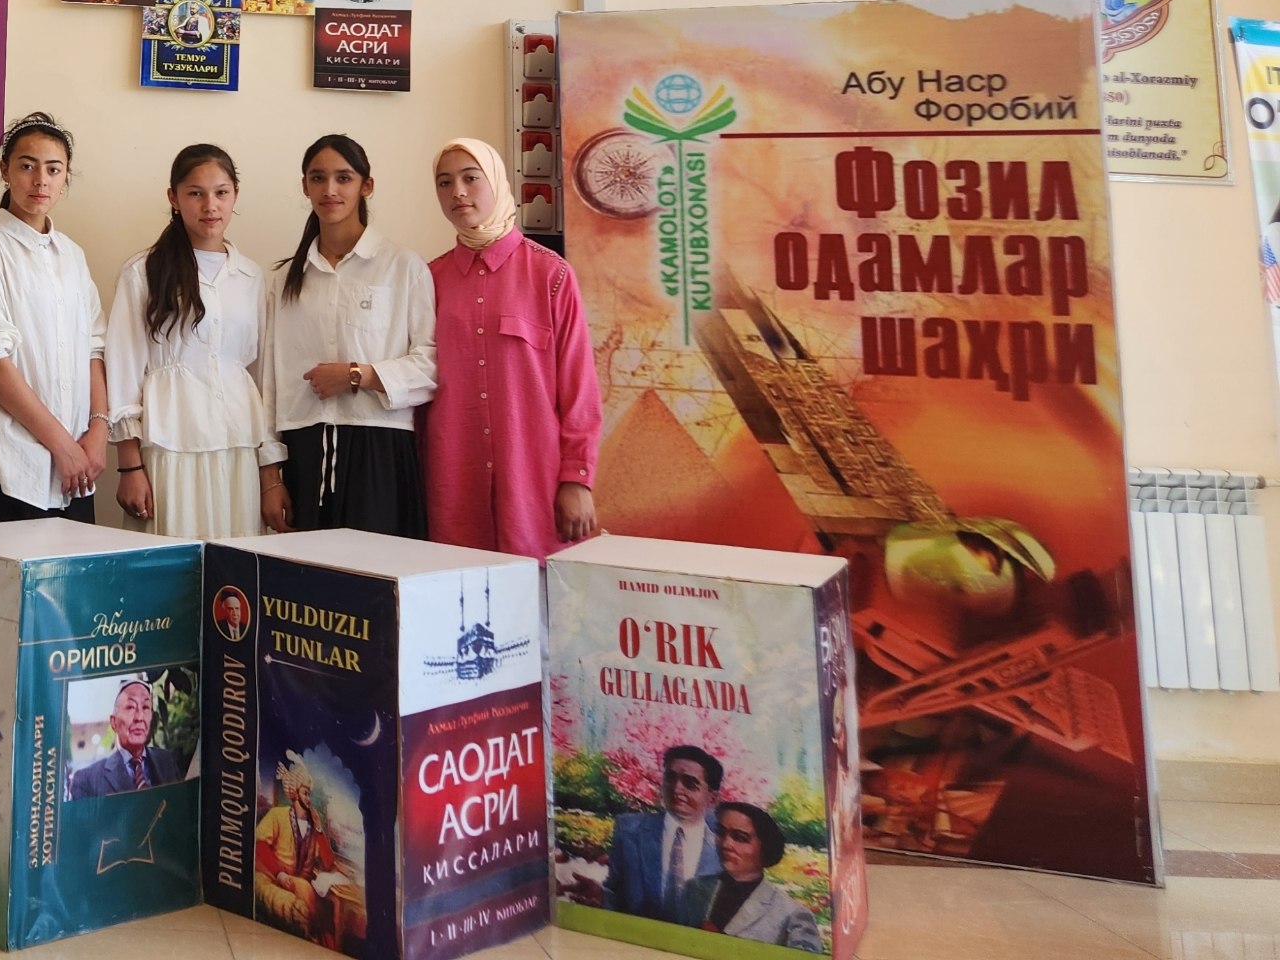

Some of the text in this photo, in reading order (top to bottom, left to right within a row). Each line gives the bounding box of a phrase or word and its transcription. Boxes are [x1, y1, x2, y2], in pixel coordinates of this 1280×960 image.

[325, 22, 403, 40] САОДАТ
[336, 40, 388, 54] АСРИ
[162, 62, 218, 73] ТУЗУКЛАРИ
[174, 54, 207, 62] ТЕМУР
[326, 56, 400, 66] ҚИССАЛАРИ
[1113, 72, 1198, 89] al-Xorazmiy
[842, 70, 1008, 99] Абу Наср
[914, 95, 1078, 127] Форобий
[1144, 119, 1182, 130] puxta
[1122, 132, 1176, 146] dunyoda
[835, 146, 1080, 221] Фозил
[657, 166, 680, 297] «KAMOLOT»
[686, 152, 712, 311] KUTUBXONASI
[773, 231, 1089, 316] одамлар
[861, 316, 1098, 401] шаҳри
[619, 580, 720, 601] HAMID OLIMJON
[91, 608, 174, 642] Абдулла
[262, 595, 370, 641] YULDUZLI
[48, 642, 137, 674] ОРИПОВ
[271, 629, 362, 673] TUNLAR
[619, 616, 725, 670] O‘RIK
[599, 666, 752, 716] GULLAGANDA
[218, 654, 249, 890] PIRIMQUL QODIROV
[418, 727, 538, 795] САОДАТ
[29, 714, 46, 868] ЗАМОНДОШЛАРИ
[42, 745, 57, 866] ХОТИРАСИДА
[438, 784, 520, 845] АСРИ
[423, 830, 540, 886] ҚИССАЛАРИ
